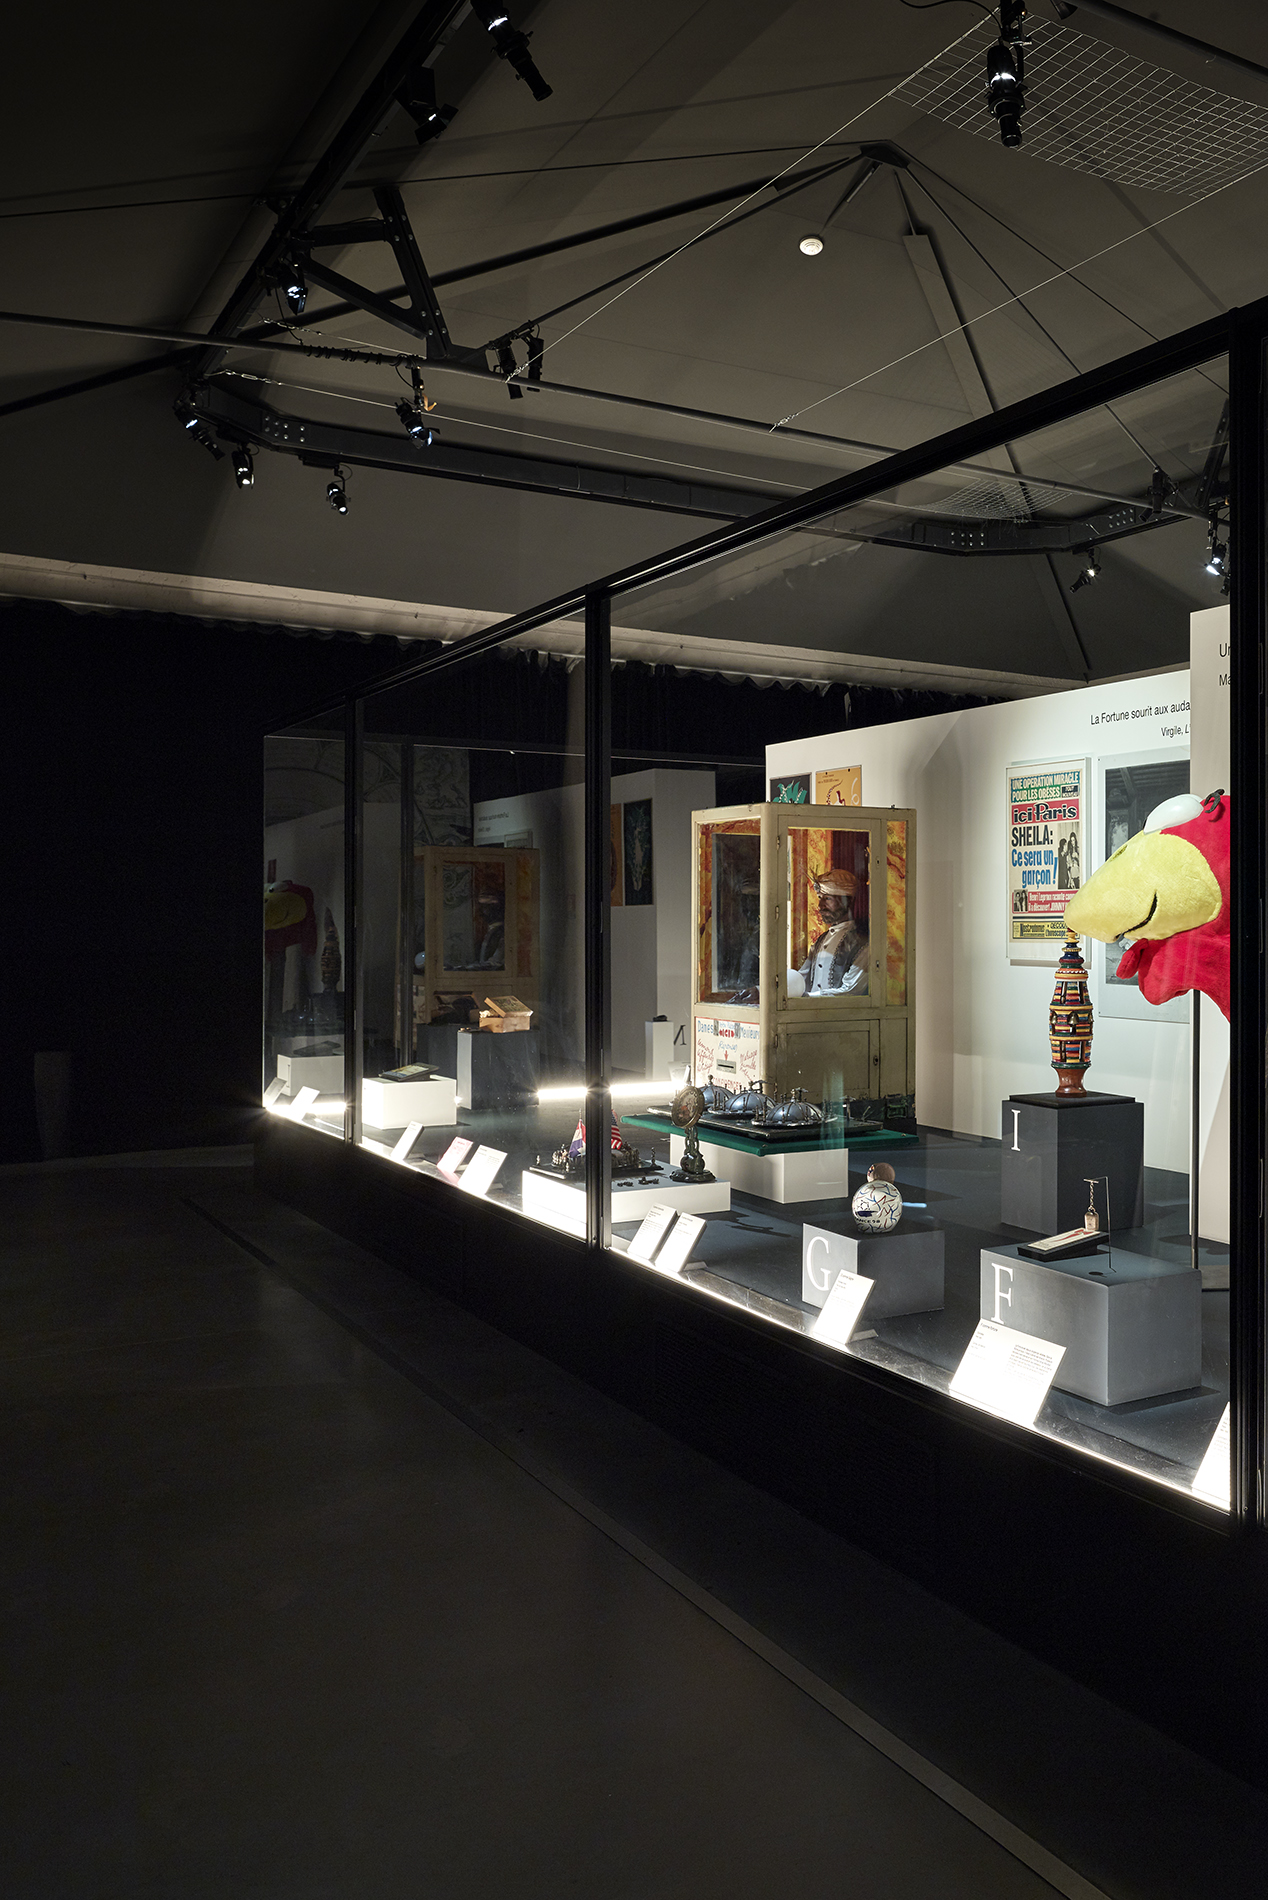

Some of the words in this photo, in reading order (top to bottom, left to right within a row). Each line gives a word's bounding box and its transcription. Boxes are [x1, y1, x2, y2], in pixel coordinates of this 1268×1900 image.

[1091, 714, 1099, 725] La
[1101, 711, 1129, 723] Fortune
[1131, 706, 1152, 719] sourit
[1154, 705, 1168, 715] aux
[1161, 725, 1183, 738] Virgile,
[1012, 778, 1023, 790] UNE
[1023, 775, 1053, 788] OPERATION
[1054, 772, 1078, 785] MIRACLE
[1012, 790, 1027, 802] POUR
[1028, 789, 1037, 800] LES
[1014, 807, 1032, 823] ici
[1034, 802, 1077, 821] Paris
[1012, 825, 1053, 846] SHEILA:
[1012, 849, 1022, 867] Ce
[1024, 850, 1042, 867] sera
[1044, 850, 1054, 865] un
[1022, 869, 1051, 889] garçon
[1011, 1109, 1021, 1151] I
[806, 1236, 832, 1291] G
[991, 1262, 1013, 1325] F
